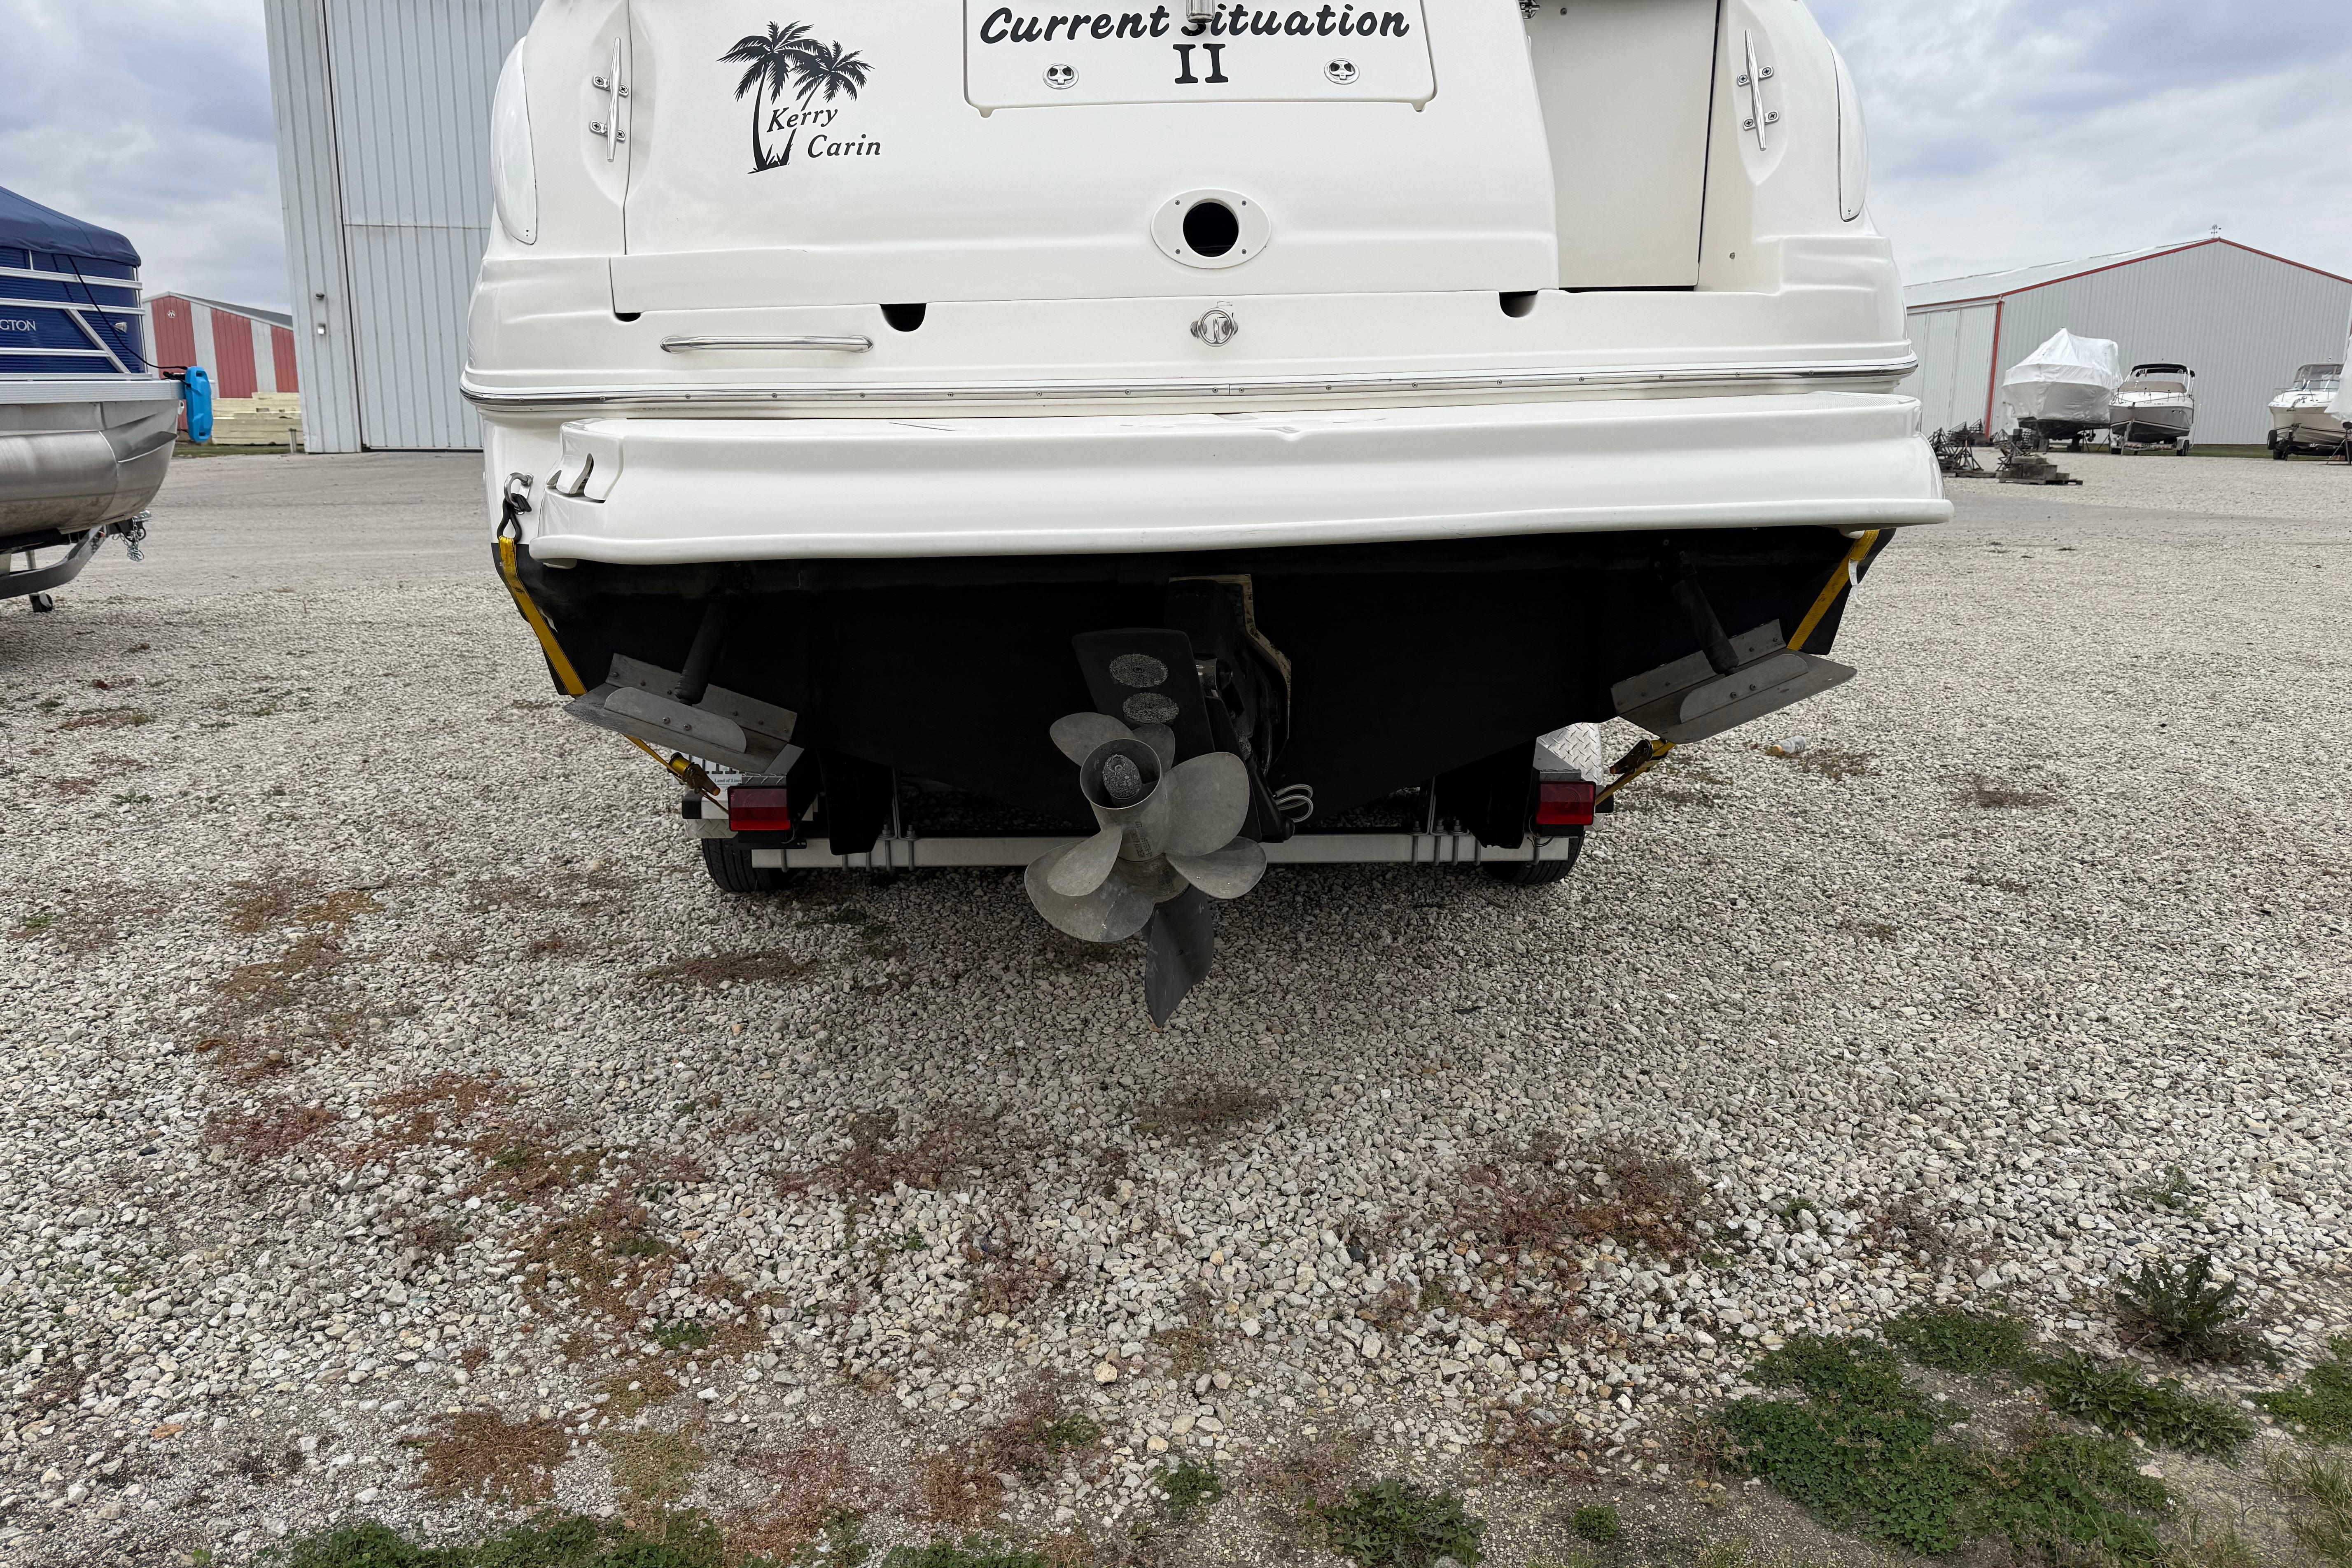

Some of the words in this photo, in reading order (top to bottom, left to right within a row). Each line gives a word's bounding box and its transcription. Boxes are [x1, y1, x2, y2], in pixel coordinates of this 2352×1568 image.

[980, 5, 1170, 44] Current
[1172, 43, 1229, 84] II
[766, 107, 838, 133] Kerry
[807, 134, 881, 158] Carin
